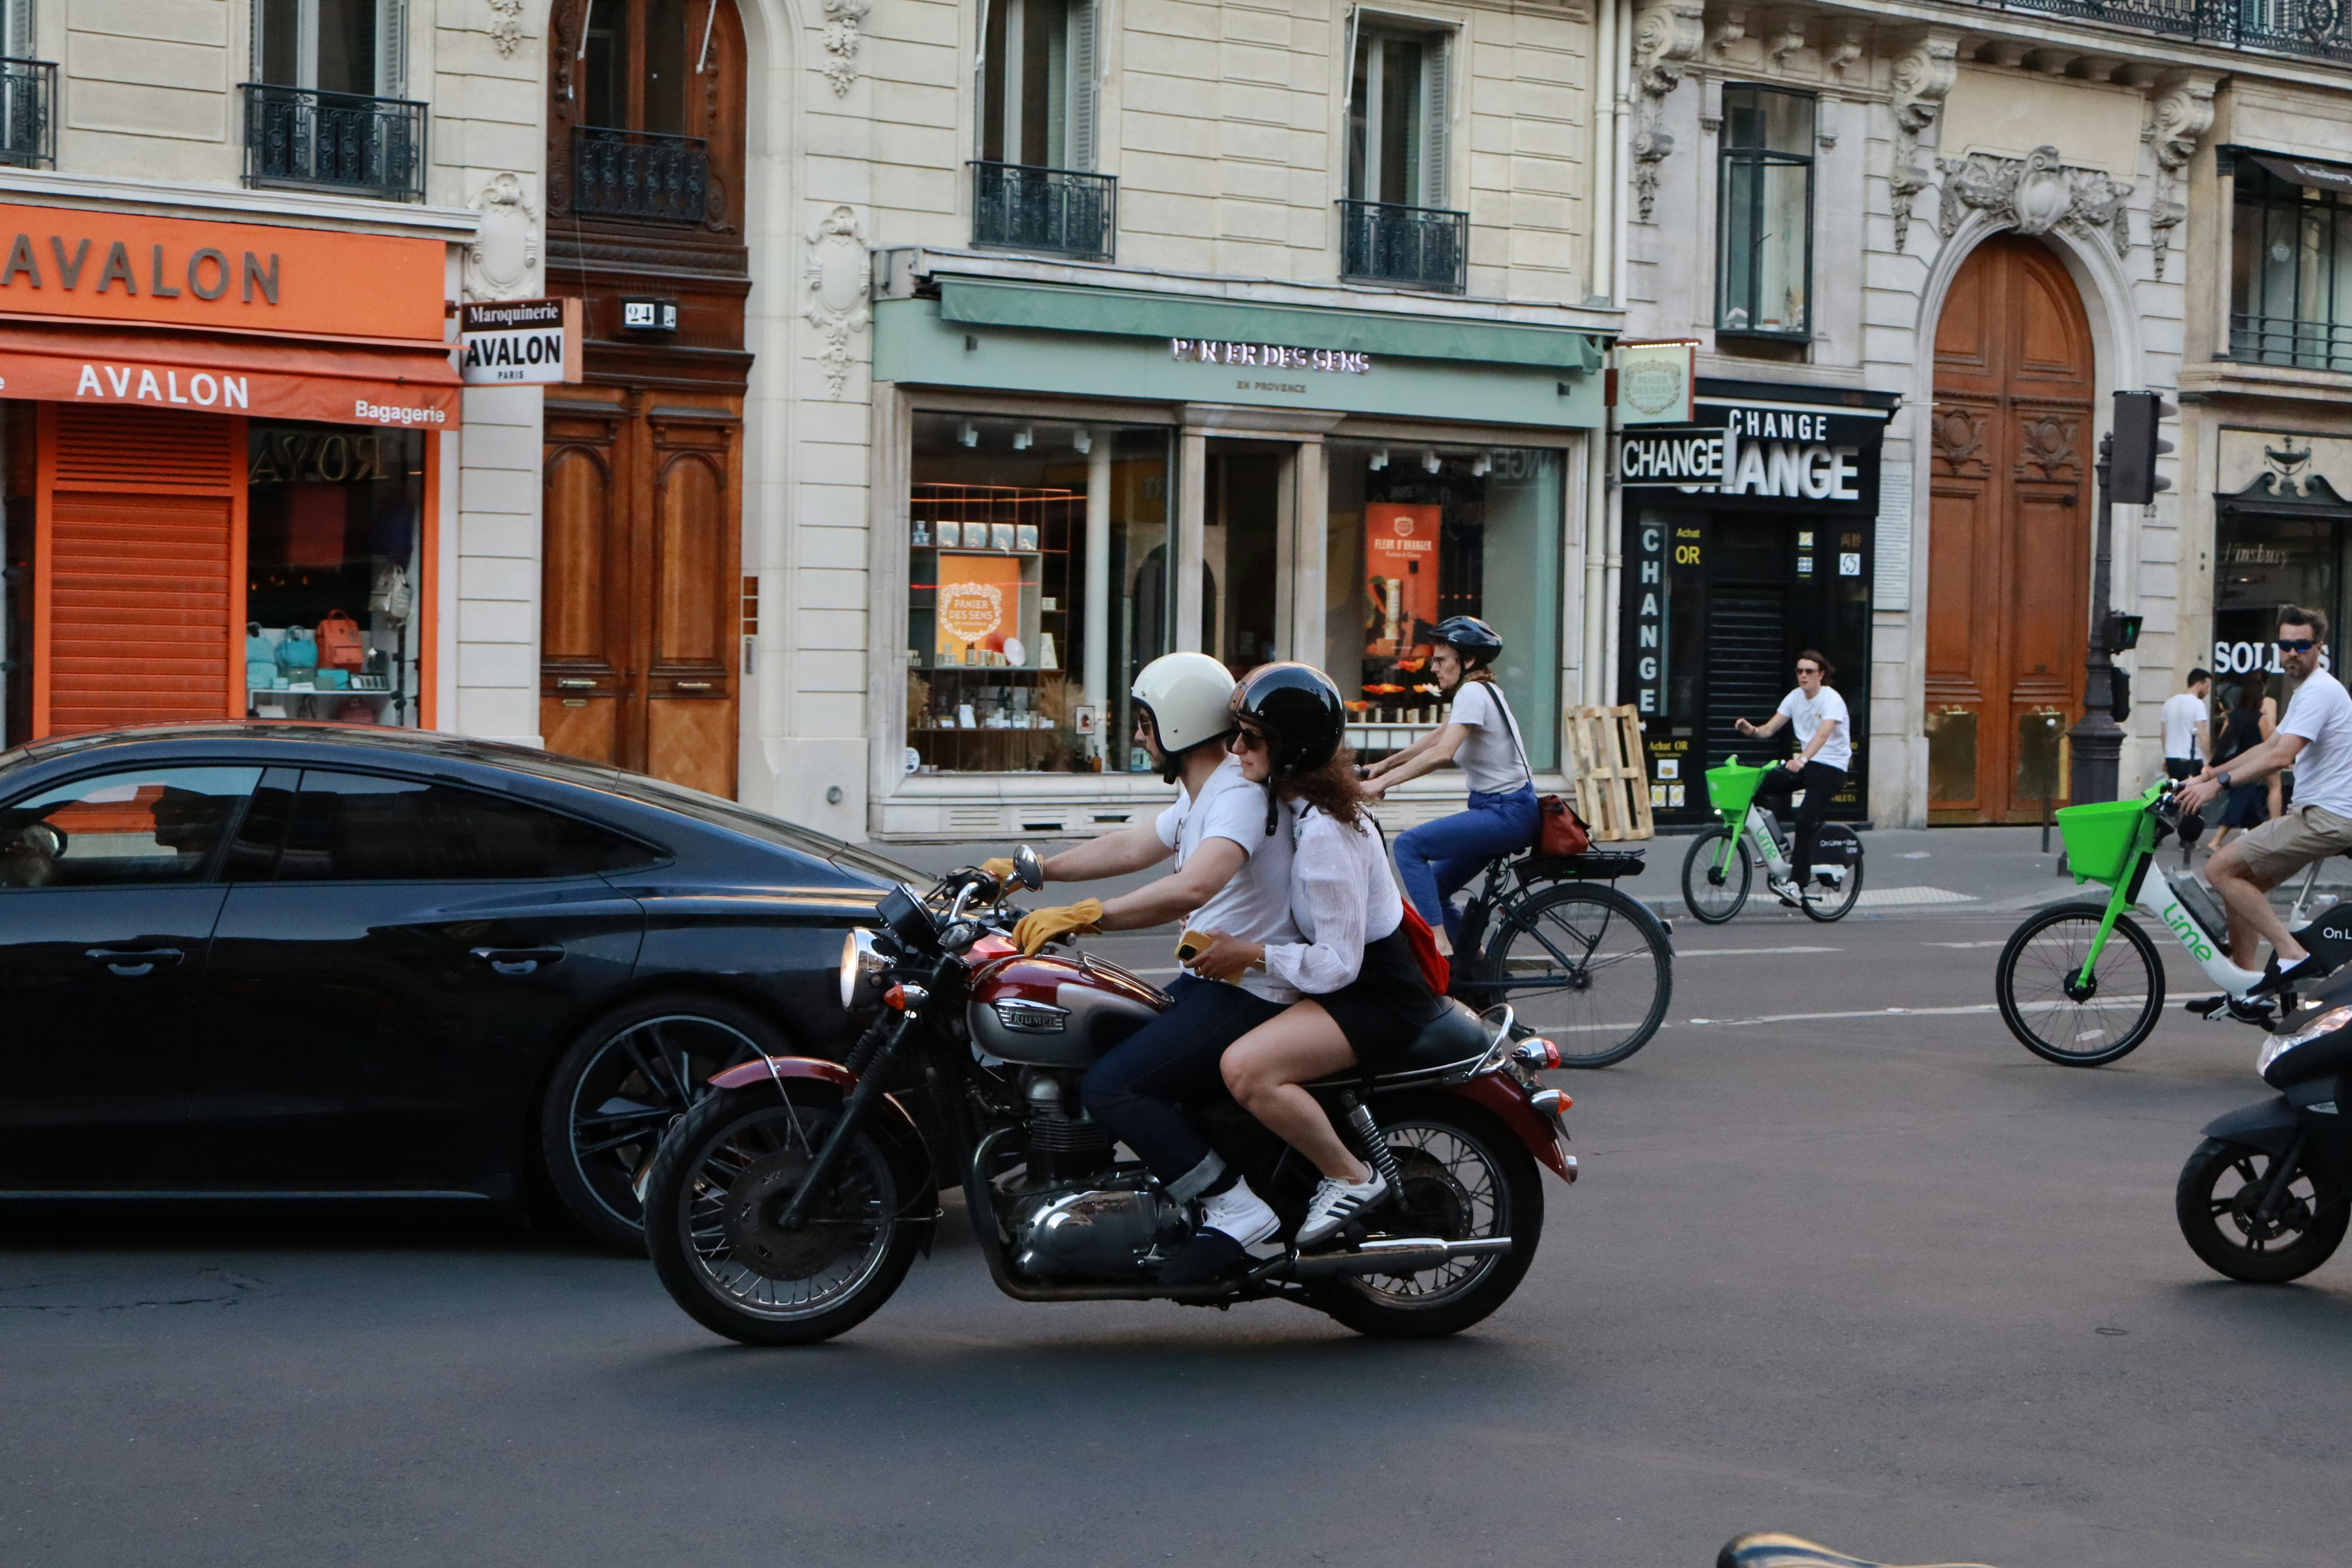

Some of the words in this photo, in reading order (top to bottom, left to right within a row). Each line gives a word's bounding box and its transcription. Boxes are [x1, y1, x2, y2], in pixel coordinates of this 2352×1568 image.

[1, 233, 279, 304] AVALON
[470, 304, 558, 328] Maroquinerie
[628, 306, 651, 321] 24
[466, 335, 561, 366] AVALON
[1312, 349, 1370, 374] SENS
[76, 365, 249, 408] AVALON
[498, 370, 524, 379] PARIS
[1237, 381, 1249, 389] EN
[1255, 381, 1306, 393] PROVENCE
[355, 400, 445, 423] Bagagerie
[1729, 409, 1827, 441] CHANGE
[1622, 439, 1723, 477] CHANGE
[1677, 440, 1859, 500] ANGE
[1675, 545, 1700, 564] OR
[949, 610, 967, 619] DES
[969, 610, 993, 620] SENS
[954, 599, 988, 609] PANIER
[1640, 528, 1659, 712] CHANGE
[1756, 825, 1777, 859] Lime
[2163, 902, 2212, 962] Lime
[2323, 927, 2342, 938] On
